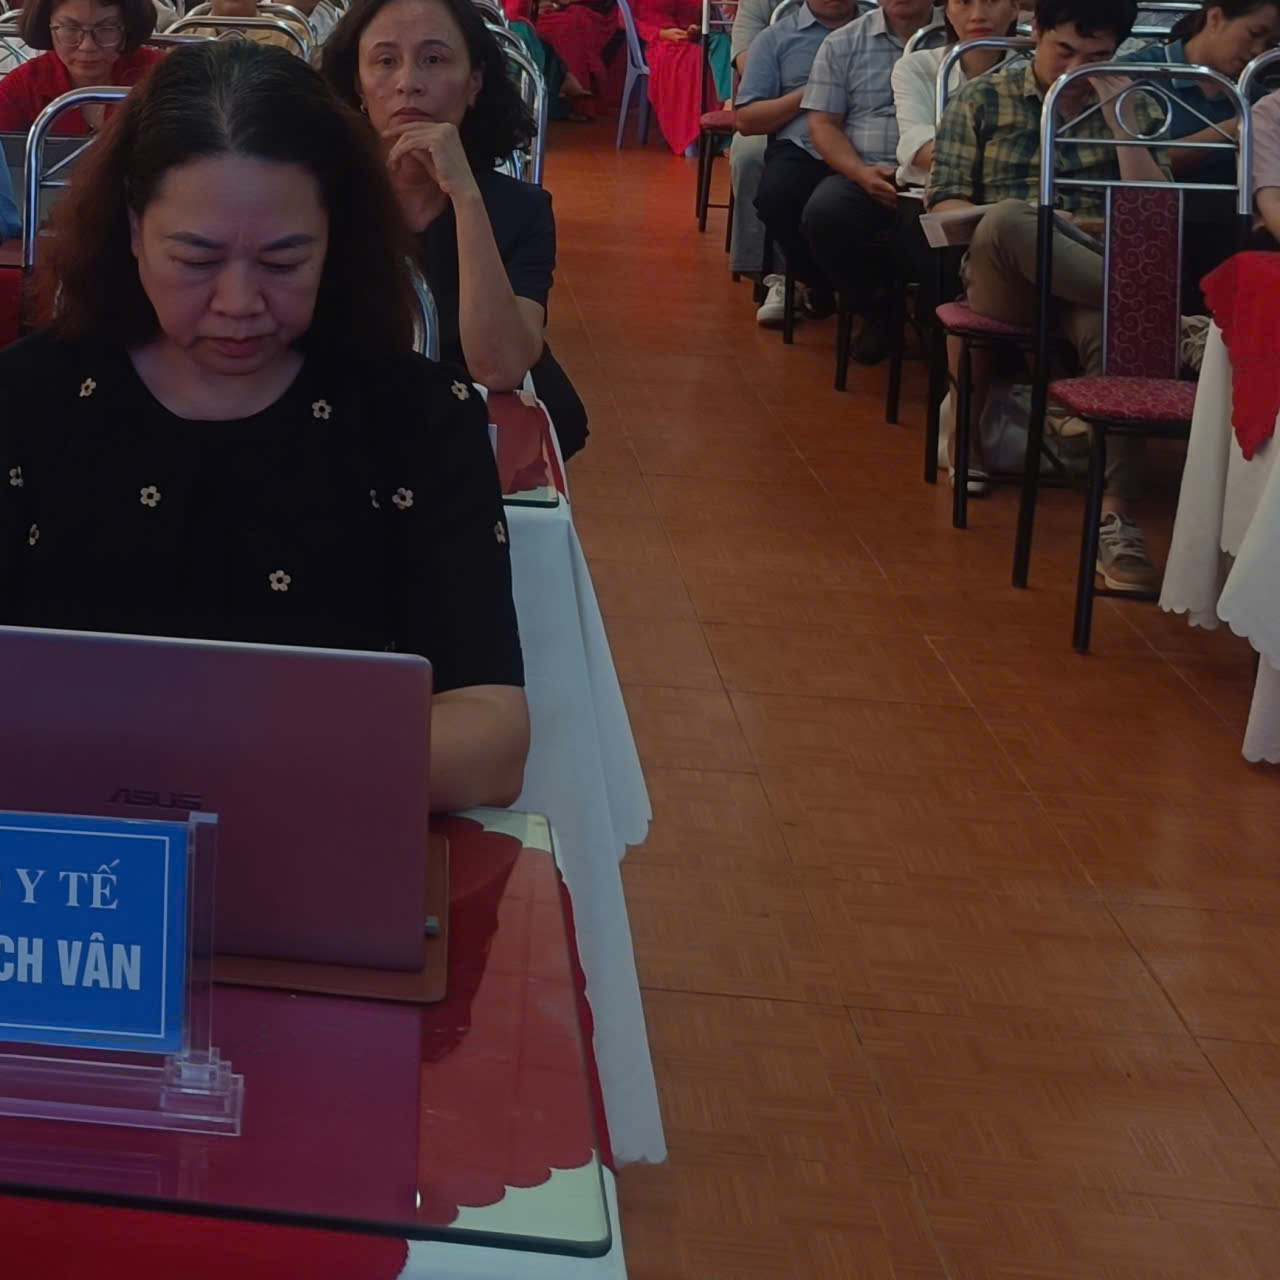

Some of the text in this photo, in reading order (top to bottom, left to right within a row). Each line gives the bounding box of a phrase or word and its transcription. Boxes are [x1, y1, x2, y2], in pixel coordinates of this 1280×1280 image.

[105, 788, 204, 810] ASUS
[16, 868, 49, 904] Y
[59, 859, 121, 910] TẾ
[57, 932, 142, 990] VÂN
